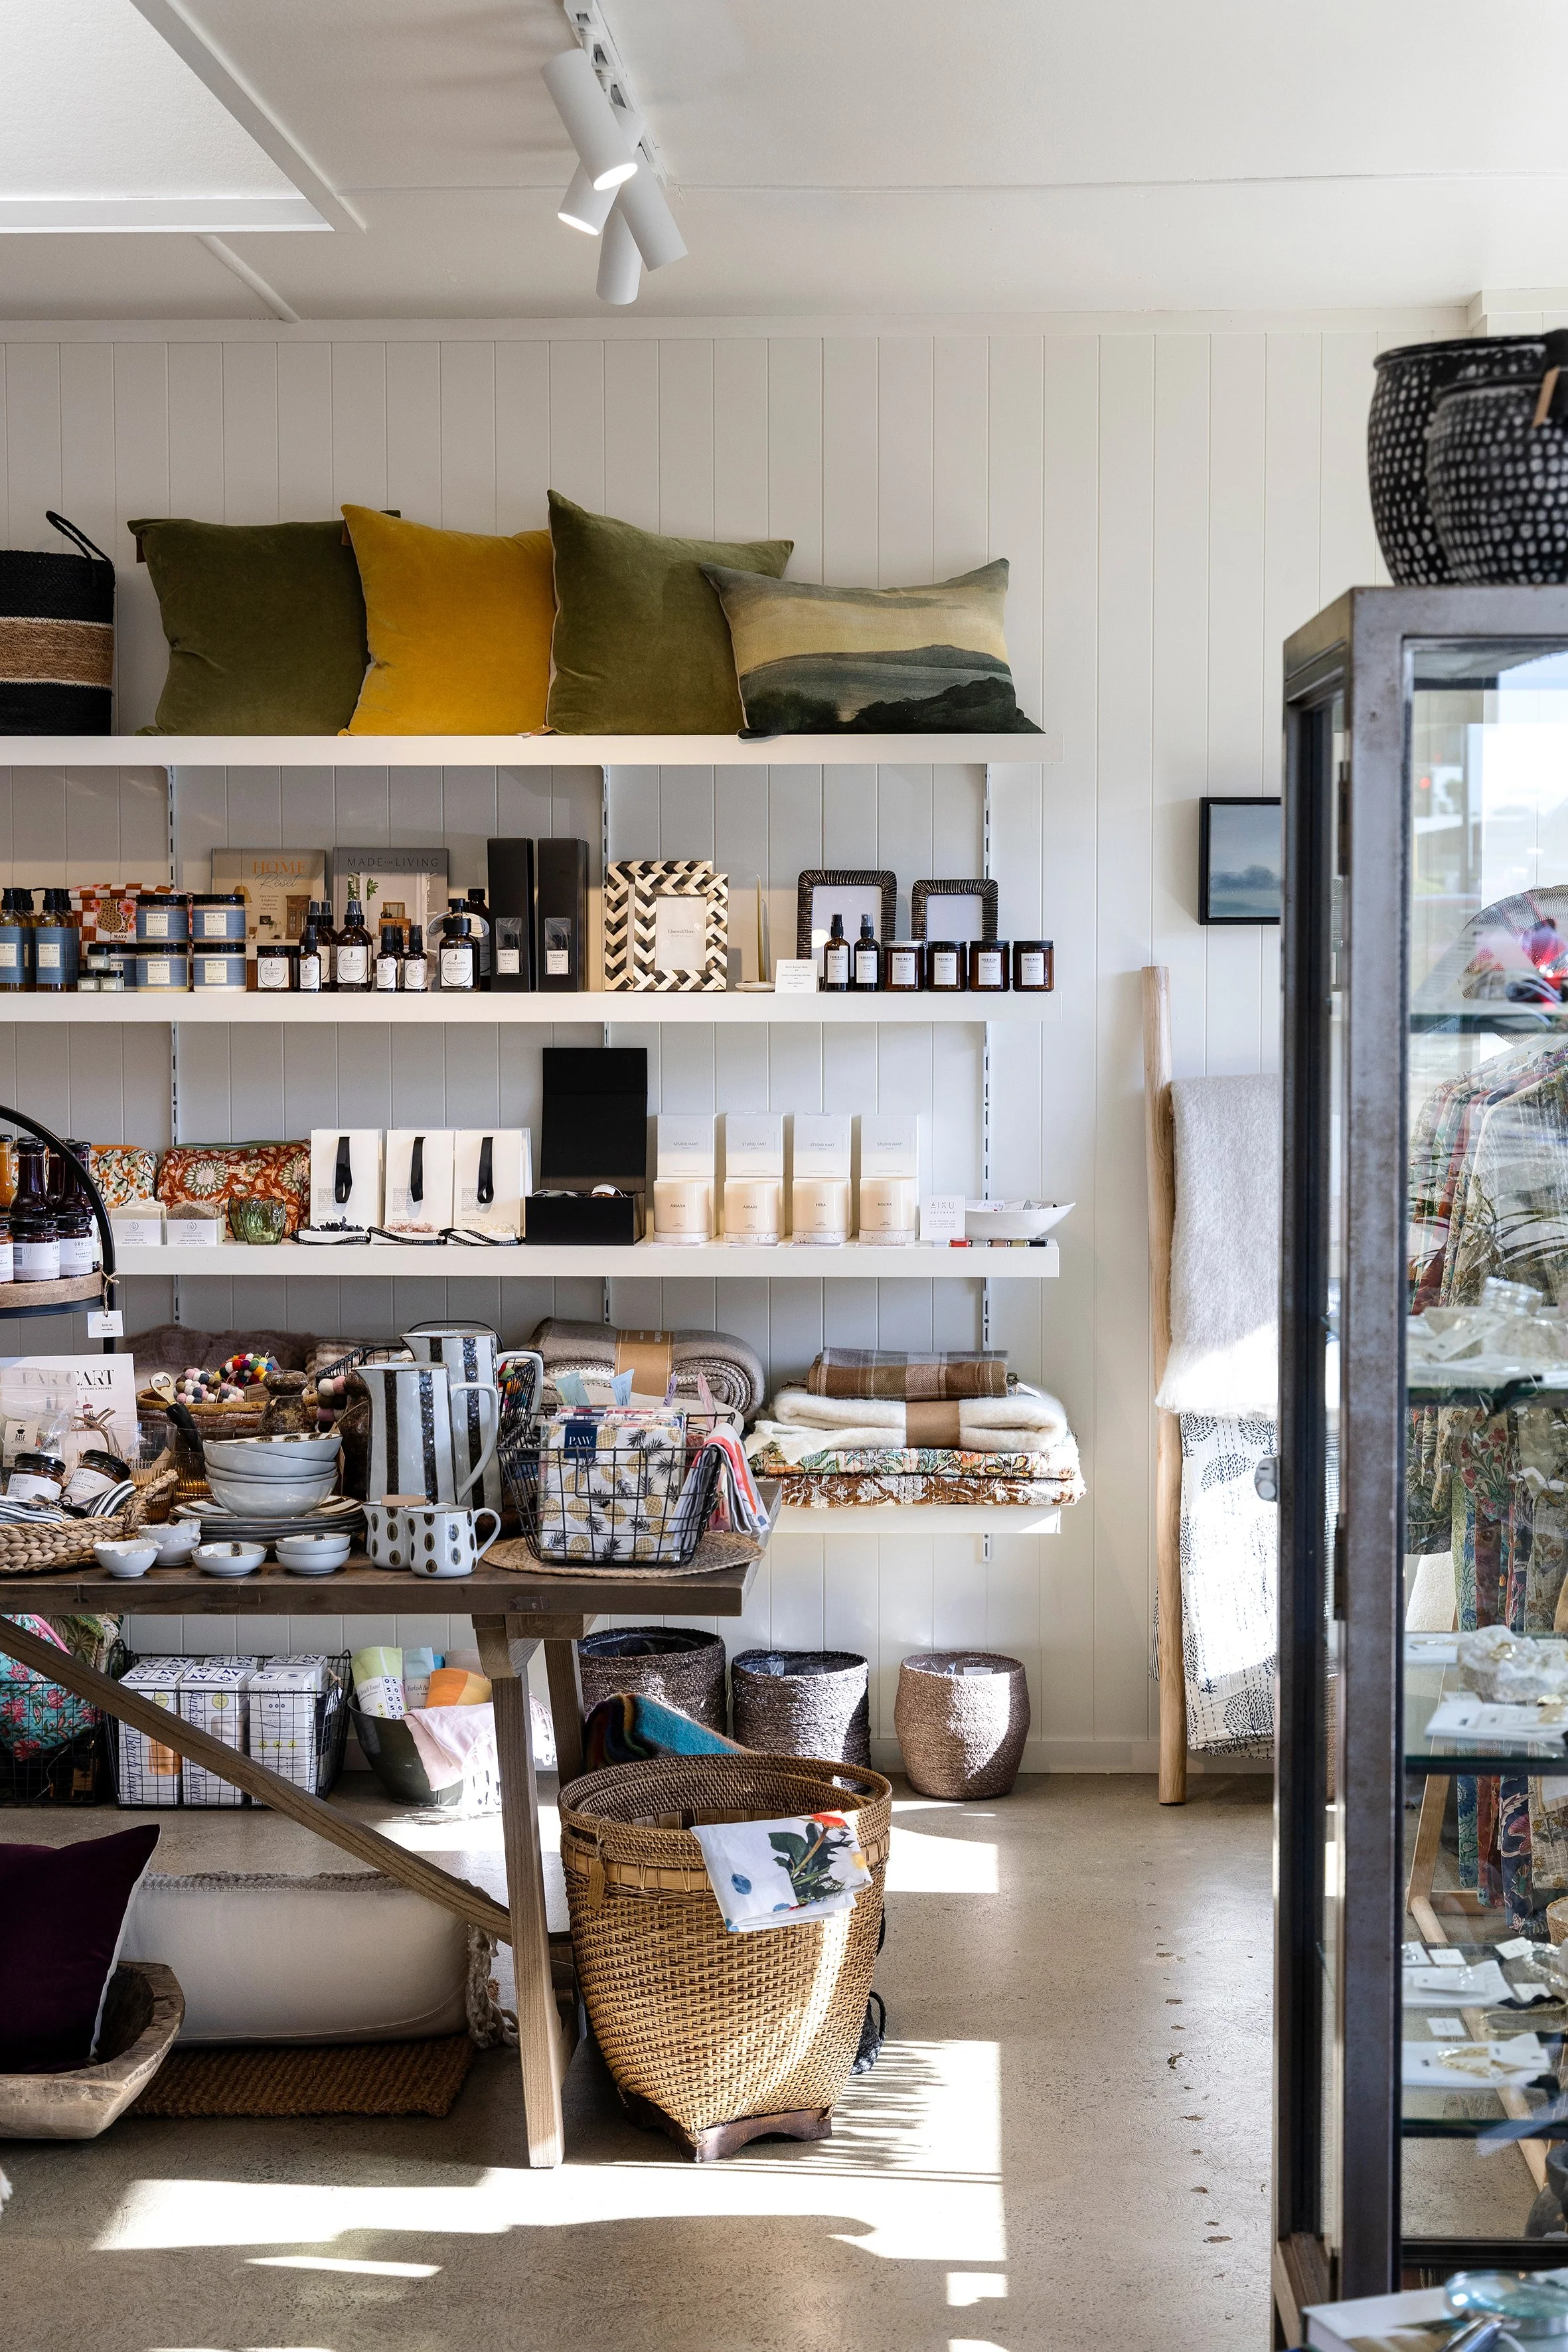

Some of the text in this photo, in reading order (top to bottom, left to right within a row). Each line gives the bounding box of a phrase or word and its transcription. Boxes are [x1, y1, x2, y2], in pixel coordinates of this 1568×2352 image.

[252, 861, 309, 874] HOME
[347, 858, 382, 866] MADE
[395, 858, 439, 867] LIVING
[255, 871, 305, 890] Reset
[66, 1370, 114, 1385] CART
[569, 1436, 593, 1445] PAW
[369, 1682, 380, 1691] Towel
[126, 1735, 143, 1802] Beach Towel
[191, 1770, 207, 1801] Towel
